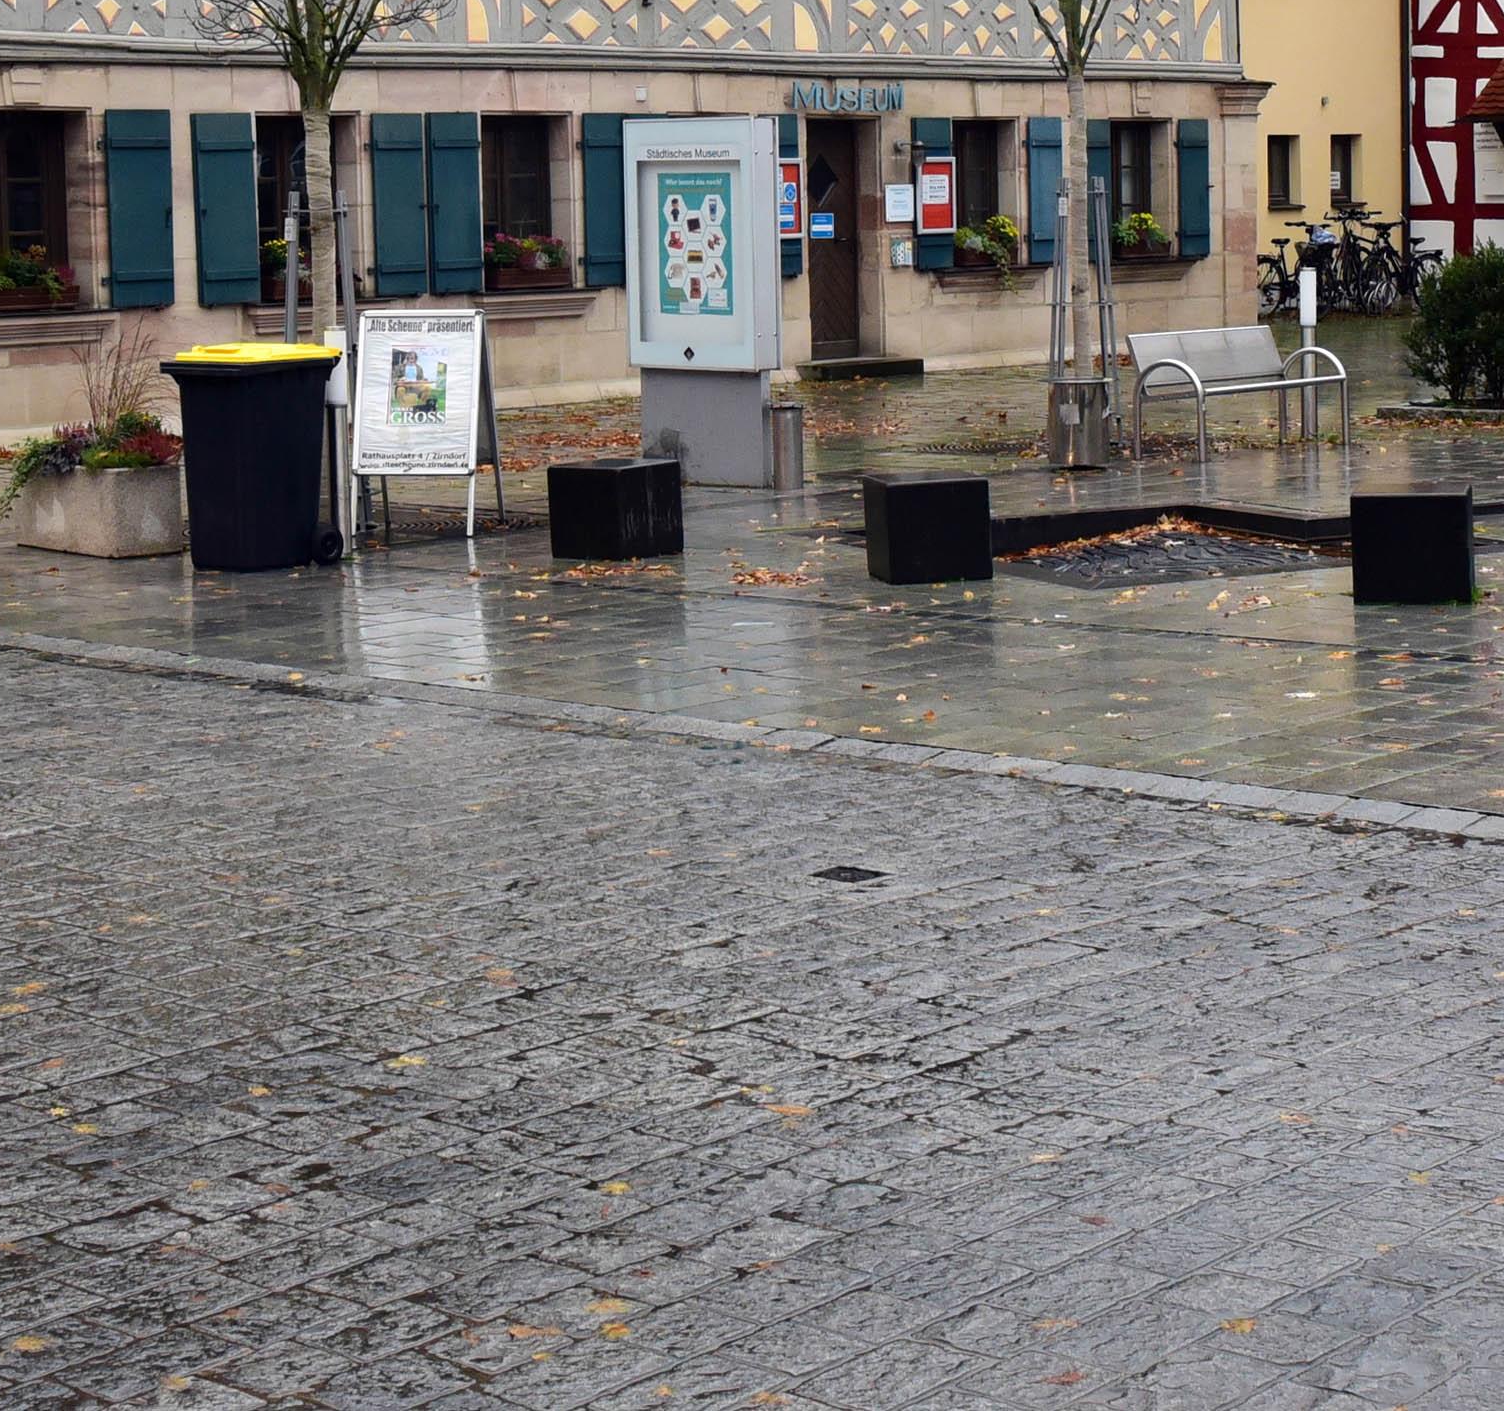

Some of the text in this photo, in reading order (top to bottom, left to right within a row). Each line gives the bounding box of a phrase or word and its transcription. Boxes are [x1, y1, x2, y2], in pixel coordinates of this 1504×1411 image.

[792, 80, 904, 112] MUSEUM
[646, 148, 730, 159] Städtisches Museum
[390, 411, 445, 424] GROSS
[432, 452, 466, 460] Zirndorf
